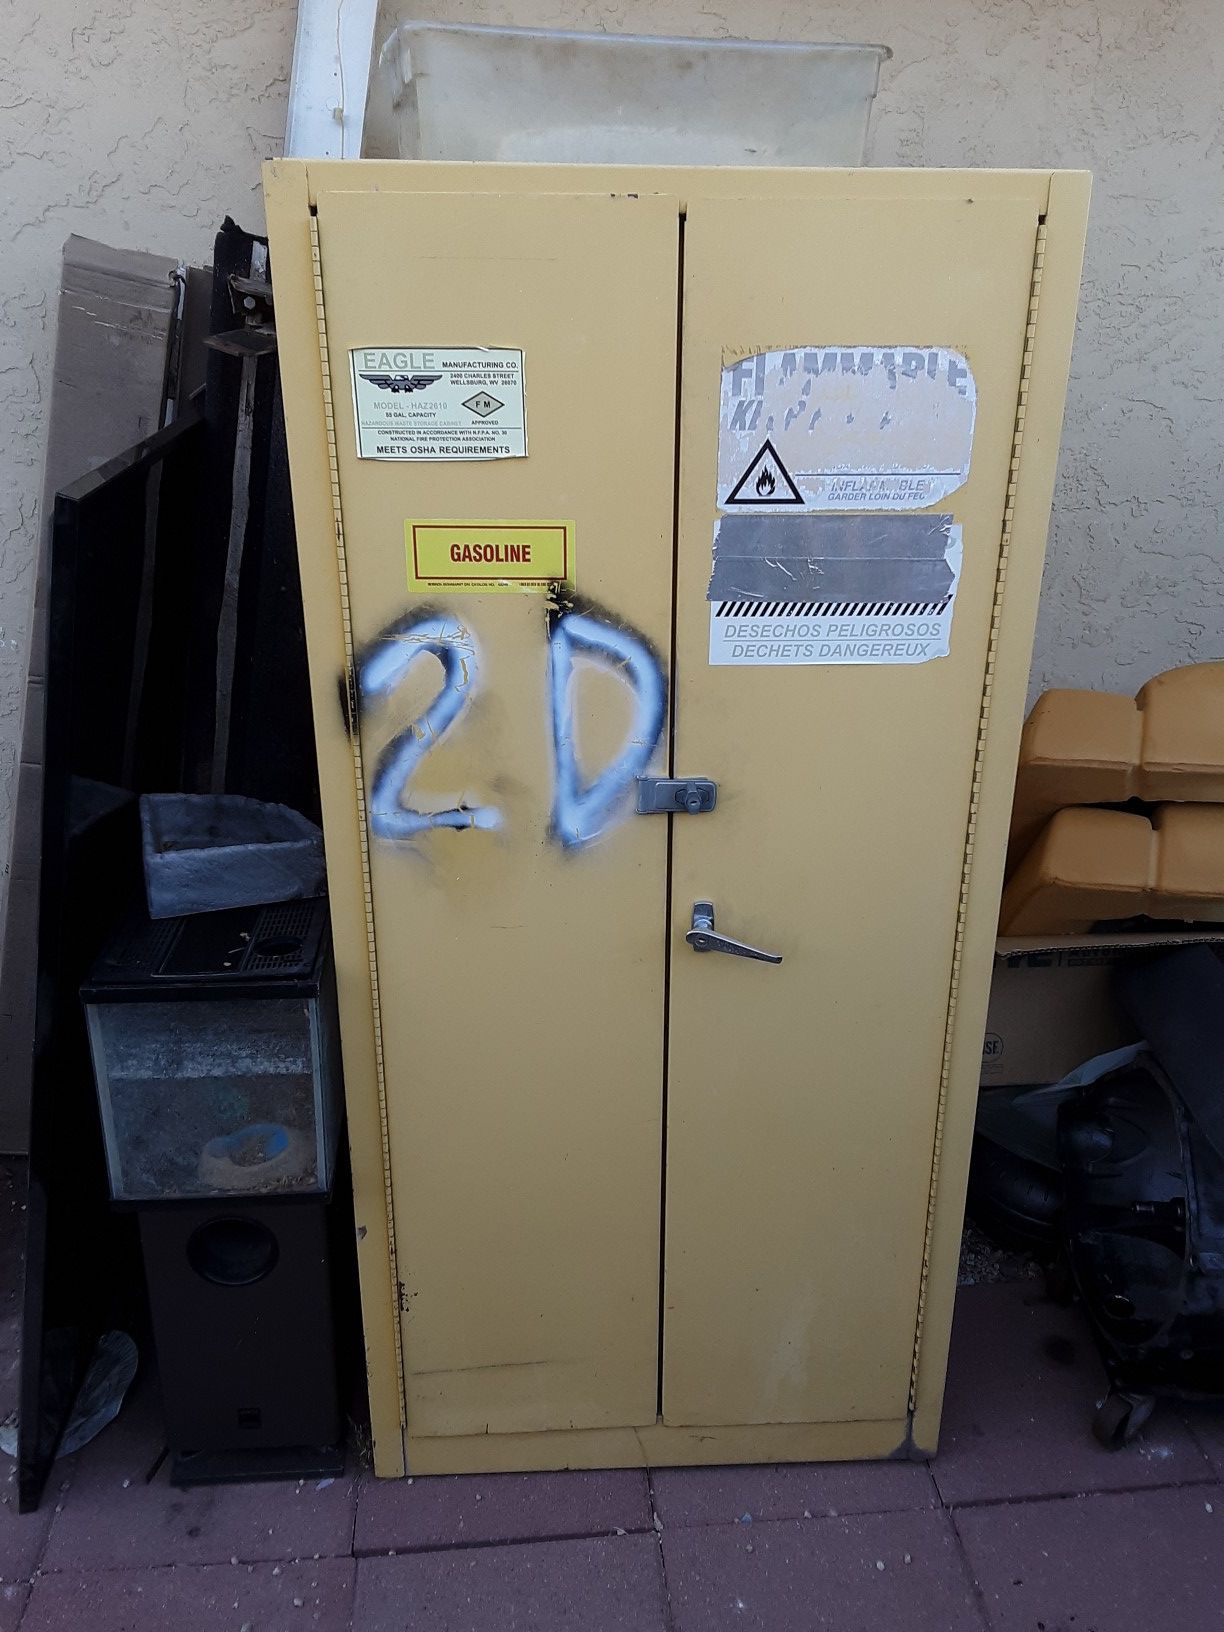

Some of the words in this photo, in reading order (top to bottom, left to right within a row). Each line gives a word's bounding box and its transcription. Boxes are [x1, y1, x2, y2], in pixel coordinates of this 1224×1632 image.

[364, 353, 436, 370] EAGLE
[442, 361, 504, 369] MANUFACTURING
[505, 361, 519, 370] CO.
[373, 401, 405, 410] MODEL
[411, 401, 448, 410] HAZ2610
[376, 445, 408, 454] MEETS
[409, 445, 437, 454] OSHA
[439, 445, 511, 454] REQUIREMENTS
[827, 492, 867, 501] GARDER
[867, 492, 891, 501] LOIN
[891, 492, 906, 501] DU
[450, 543, 532, 563] GASOLINE
[724, 623, 821, 639] DESECHOS
[826, 622, 942, 639] PELIGROSOS
[731, 643, 814, 658] DECHETS
[818, 643, 932, 658] DANGEREUX
